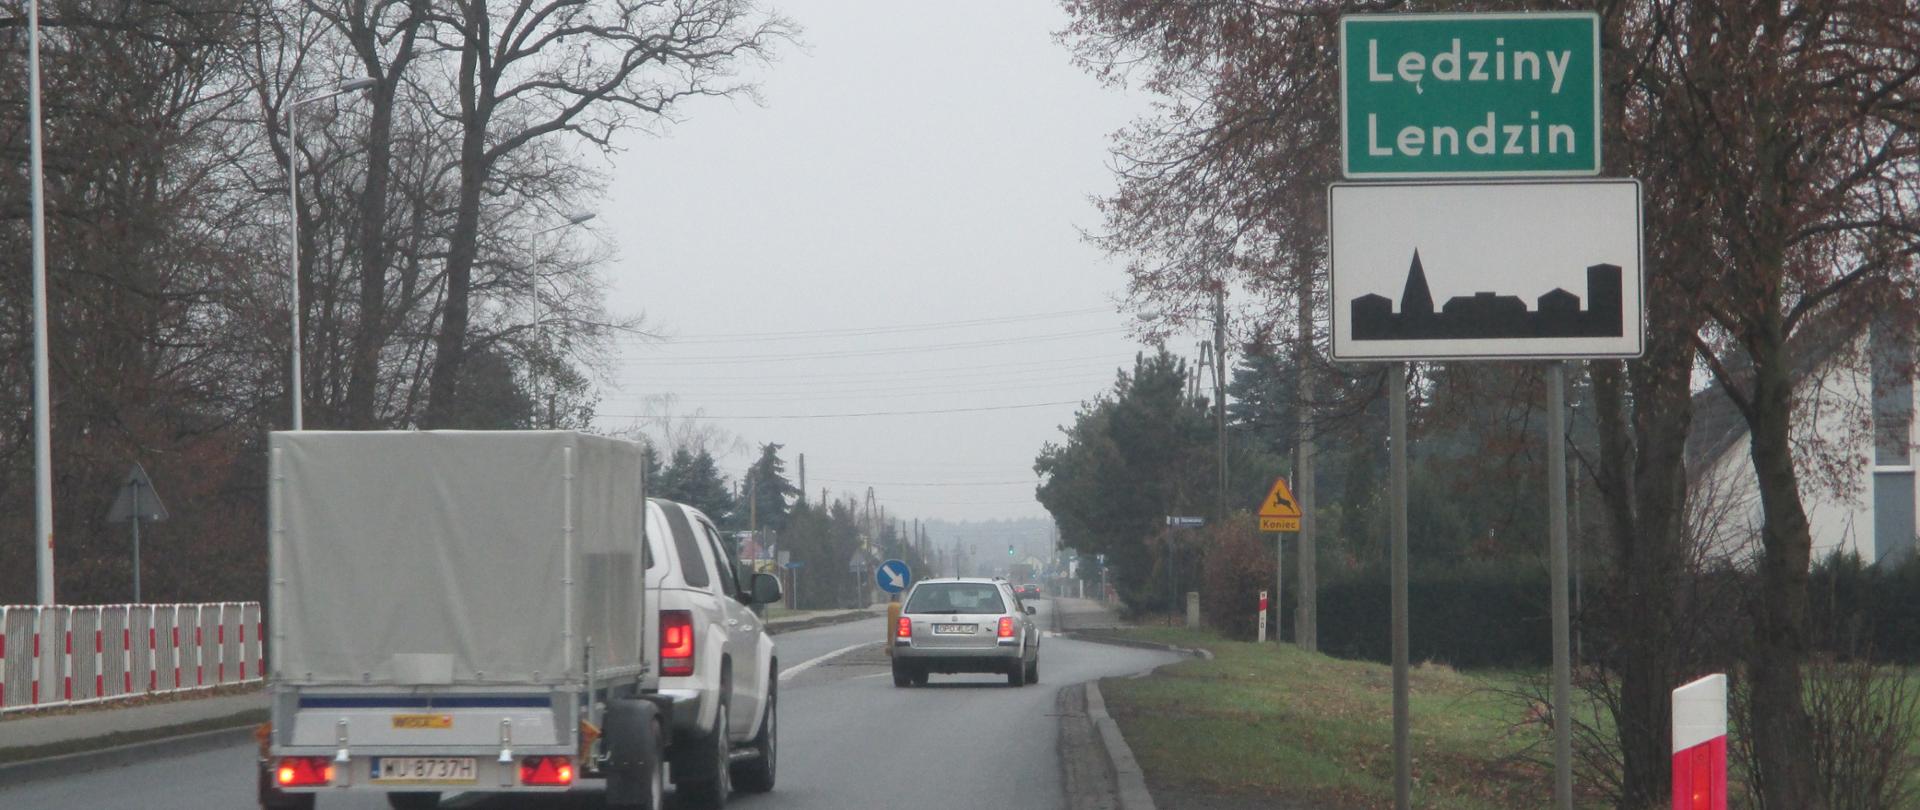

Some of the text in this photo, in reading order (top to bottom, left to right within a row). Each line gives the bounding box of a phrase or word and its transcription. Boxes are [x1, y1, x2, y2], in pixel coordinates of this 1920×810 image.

[1369, 37, 1571, 95] Lędziny
[1368, 111, 1576, 156] Lendzin
[1263, 519, 1296, 529] Koniec
[415, 759, 473, 777] 8737H
